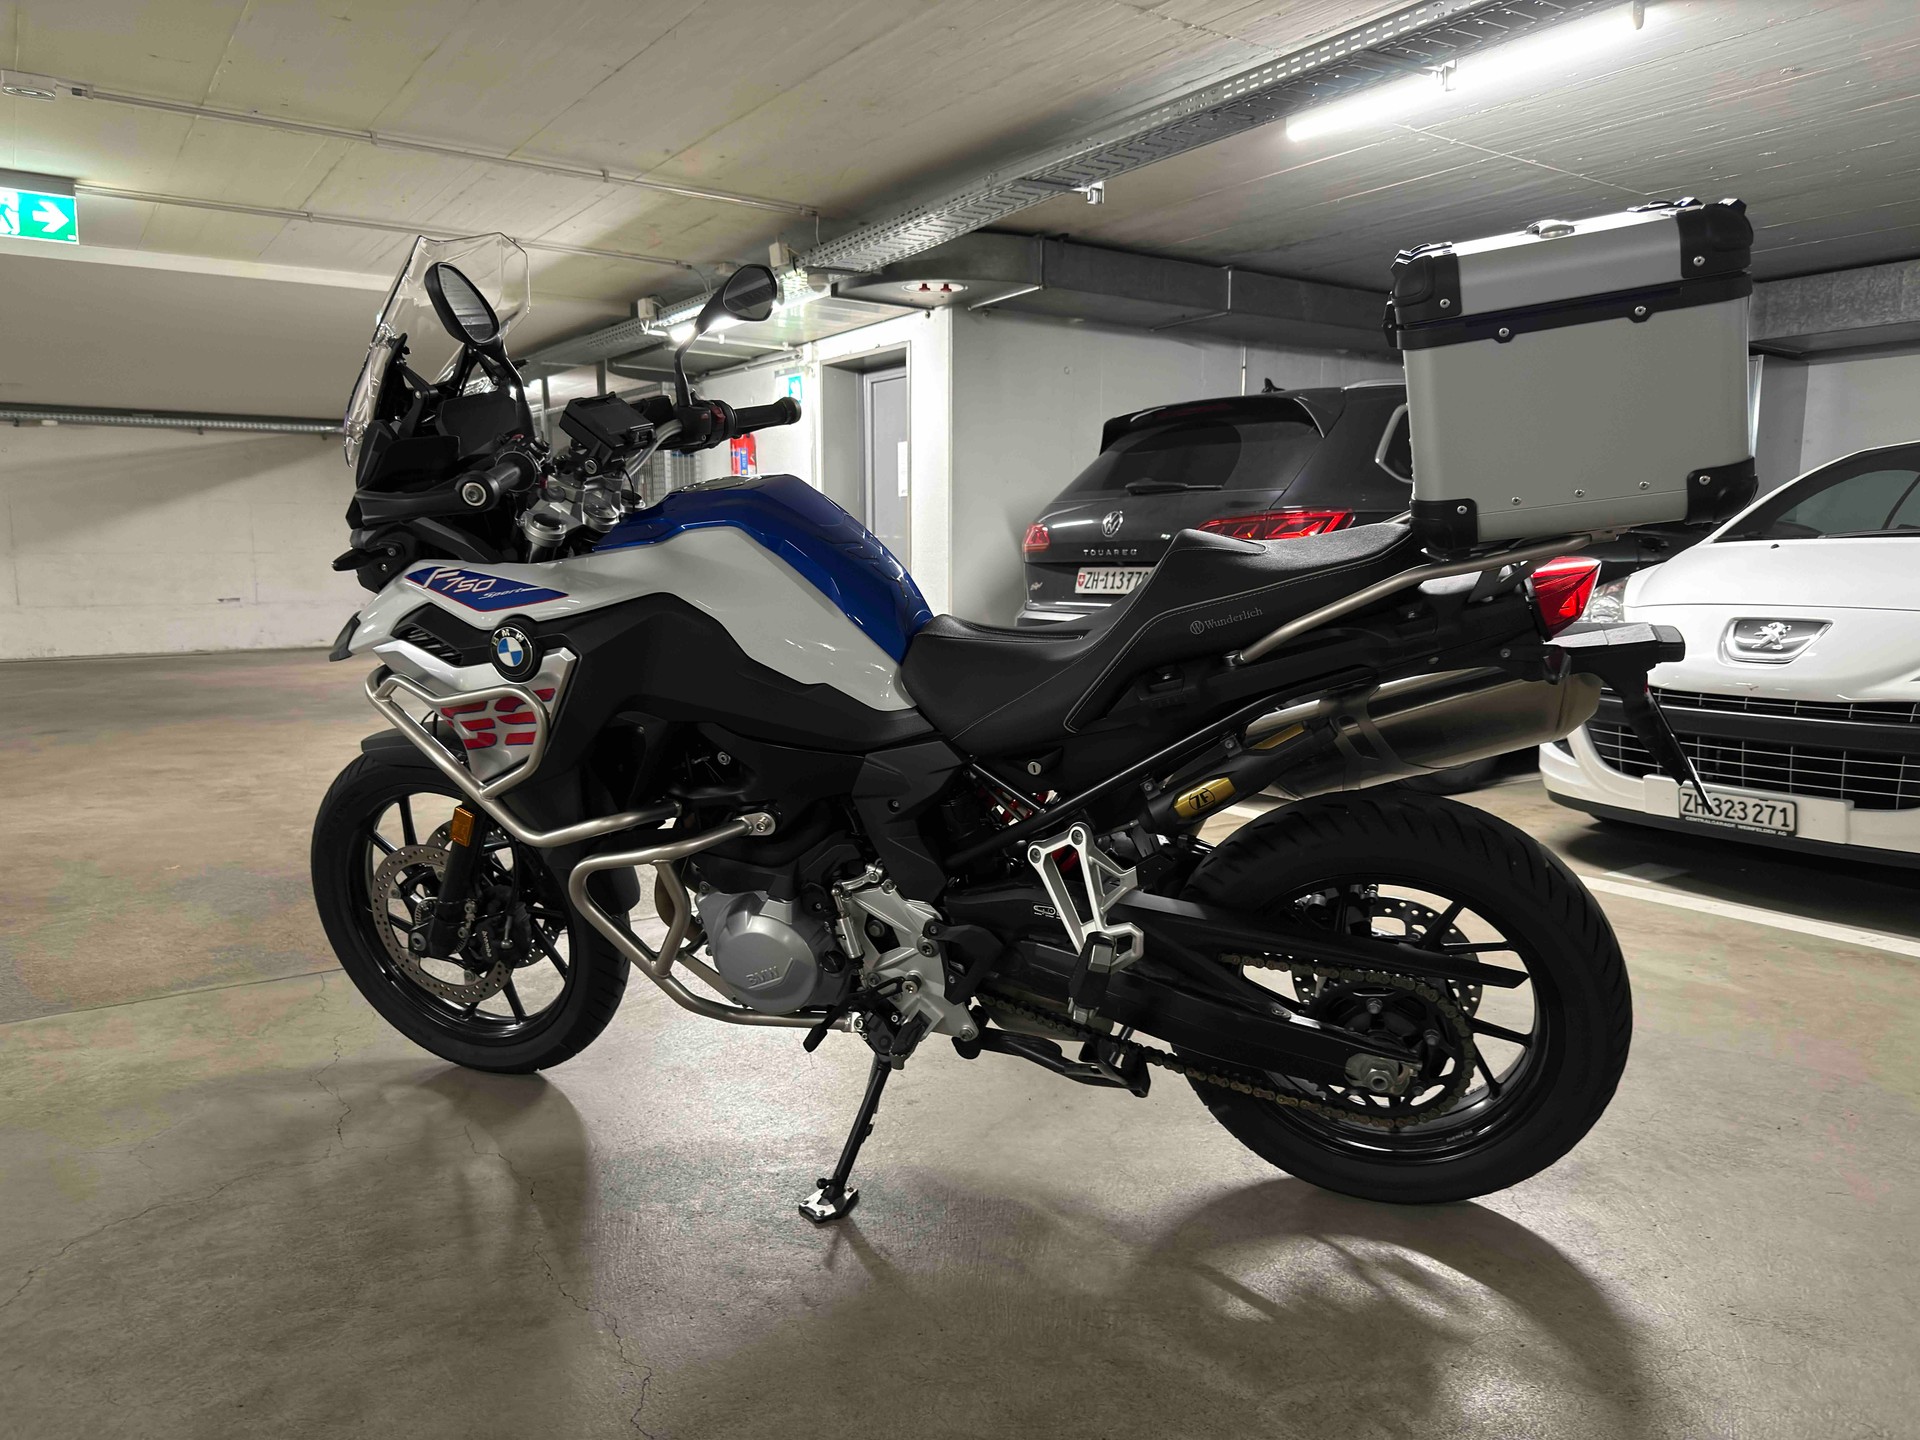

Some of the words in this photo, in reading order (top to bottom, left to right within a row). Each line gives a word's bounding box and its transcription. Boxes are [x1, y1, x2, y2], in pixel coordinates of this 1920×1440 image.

[1204, 607, 1264, 630] Wunderlich
[491, 628, 525, 647] BMW
[1189, 788, 1213, 810] ZF
[1752, 803, 1790, 828] 271
